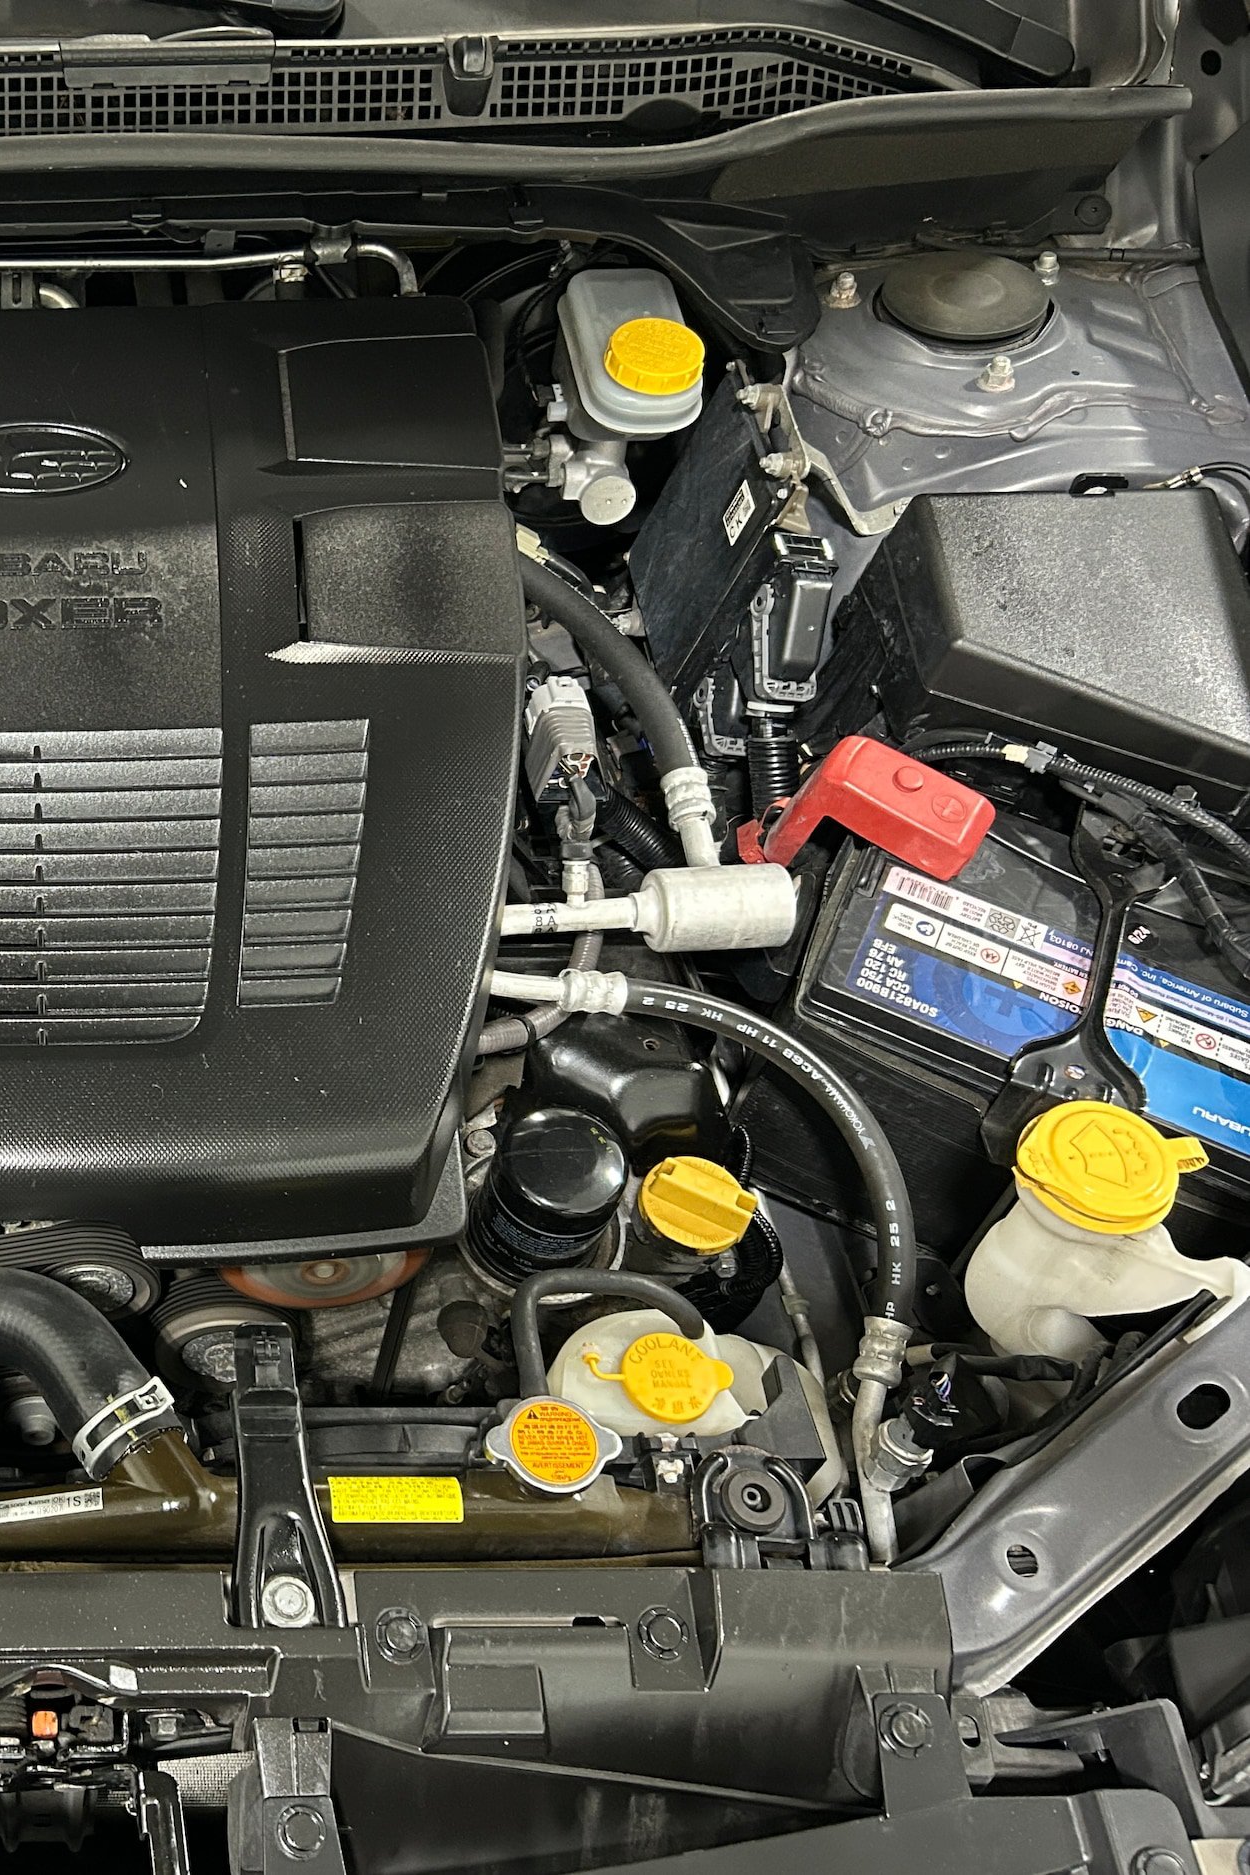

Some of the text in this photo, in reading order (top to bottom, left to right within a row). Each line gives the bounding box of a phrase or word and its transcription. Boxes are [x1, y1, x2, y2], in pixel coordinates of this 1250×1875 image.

[1127, 925, 1151, 944] 6/24
[871, 937, 897, 954] EFB
[1079, 946, 1094, 956] NJ
[863, 956, 907, 981] RC 120
[885, 954, 904, 968] Ah
[859, 966, 911, 994] CCA 750
[1116, 956, 1249, 1018] Subaru of America, Inc. Cam
[641, 995, 654, 1006] 2
[664, 1000, 689, 1012] 25
[1038, 991, 1080, 1014] OISON
[700, 1007, 723, 1021] HK
[735, 1020, 758, 1038] HP
[1104, 1018, 1144, 1036] DANG
[761, 1033, 778, 1049] 11
[823, 1083, 866, 1135] YOKOHAMA
[1192, 1106, 1250, 1136] UBARU
[885, 1199, 896, 1210] 2
[889, 1222, 900, 1246] 25
[890, 1261, 901, 1284] HK
[628, 1336, 704, 1364] COOLANT
[654, 1359, 674, 1368] SEE
[653, 1379, 692, 1389] MANUAL
